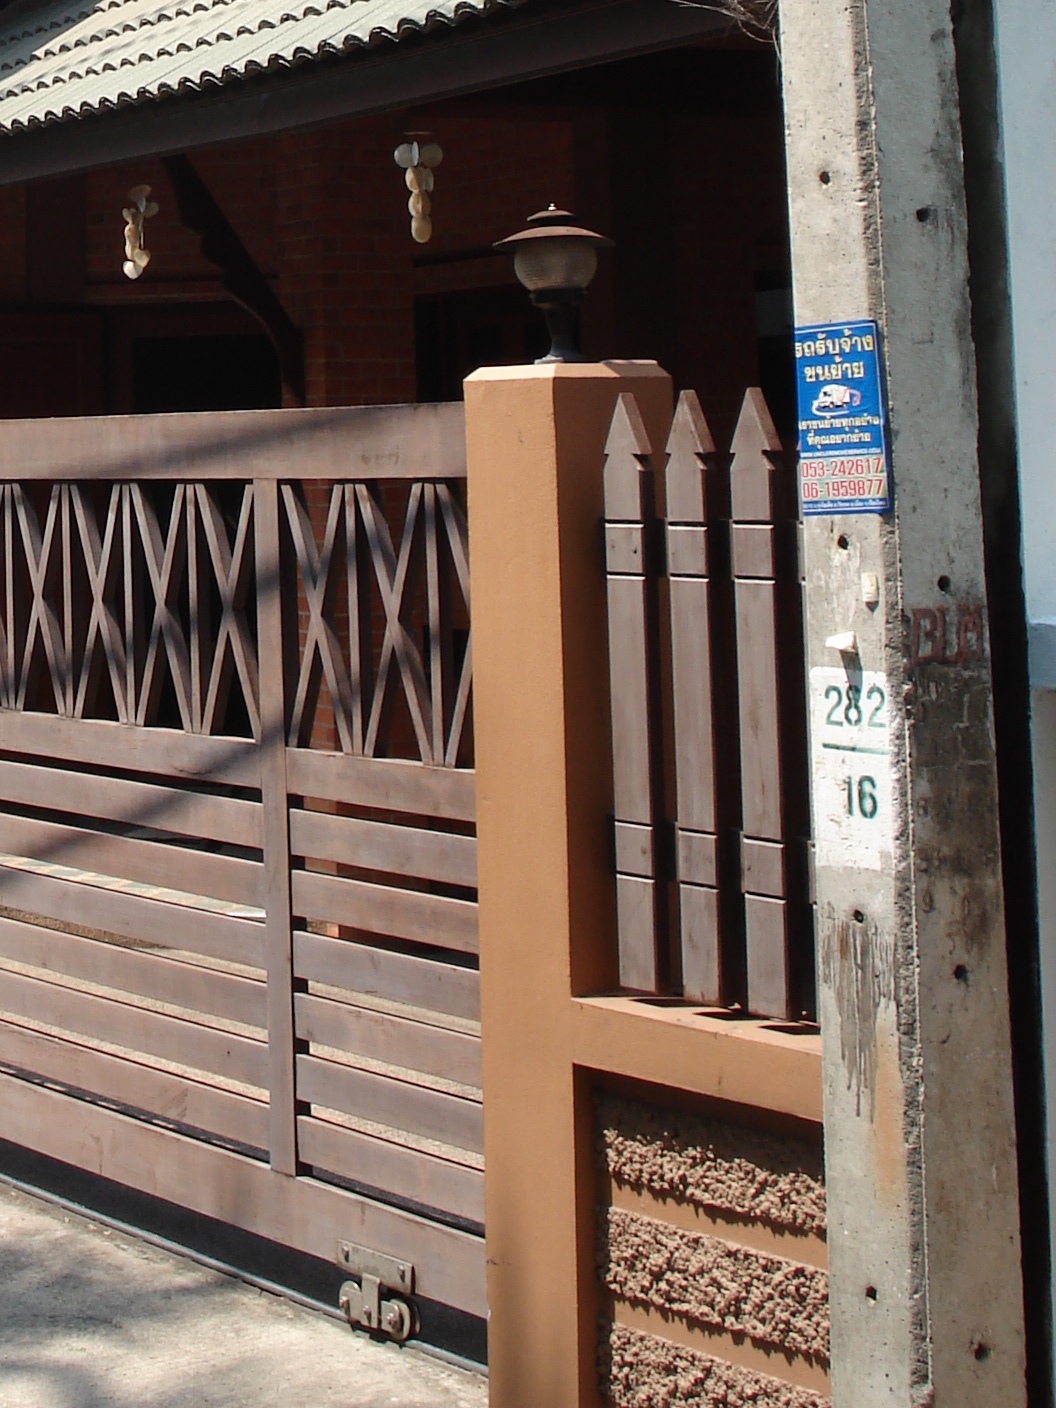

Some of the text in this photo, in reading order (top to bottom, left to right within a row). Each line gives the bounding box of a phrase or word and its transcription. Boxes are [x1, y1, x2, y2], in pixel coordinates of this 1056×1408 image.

[795, 328, 874, 358] รถรับจ้าง
[804, 355, 865, 382] ขนย้าย
[801, 457, 881, 478] 053-242617
[803, 478, 883, 498] 06-1959877
[824, 685, 887, 728] 282
[845, 775, 878, 819] 16
